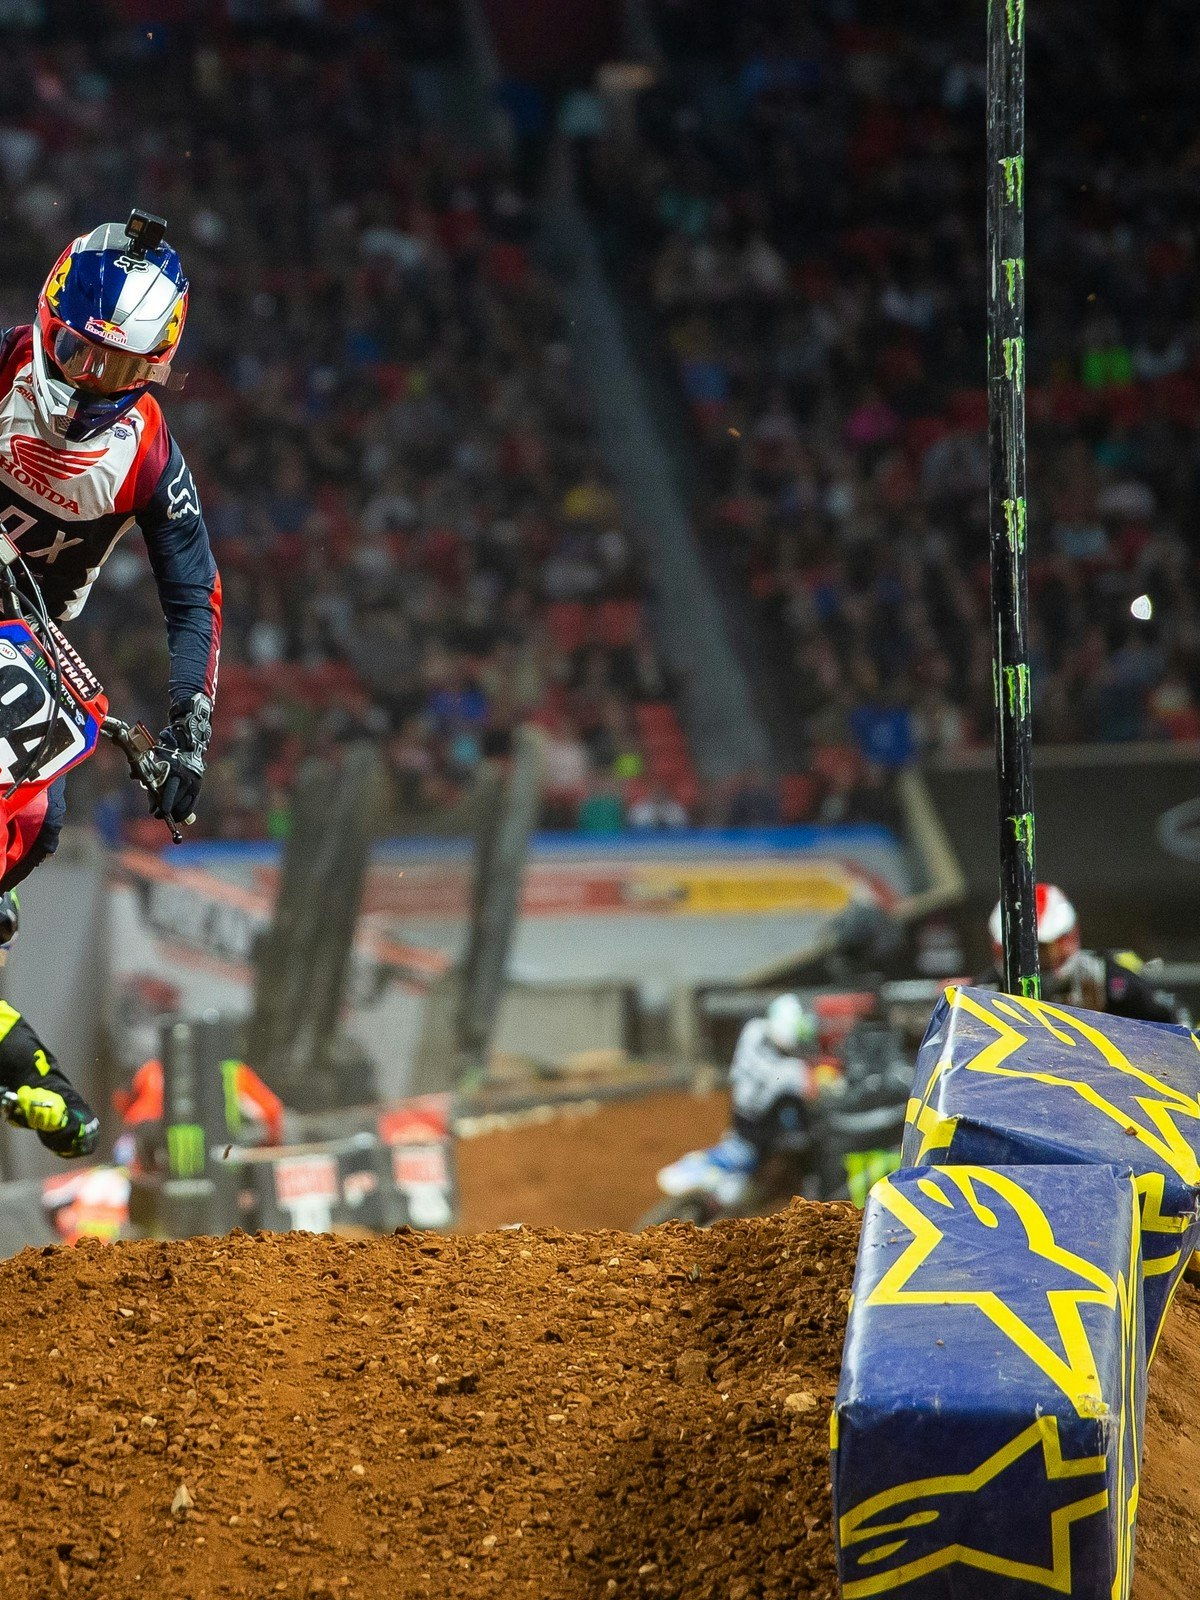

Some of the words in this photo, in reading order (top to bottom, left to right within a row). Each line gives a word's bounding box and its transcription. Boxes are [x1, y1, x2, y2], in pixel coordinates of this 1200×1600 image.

[85, 322, 107, 339] Red
[106, 332, 127, 345] Bull
[46, 643, 91, 699] NTHAL
[47, 619, 98, 690] RENTHAL
